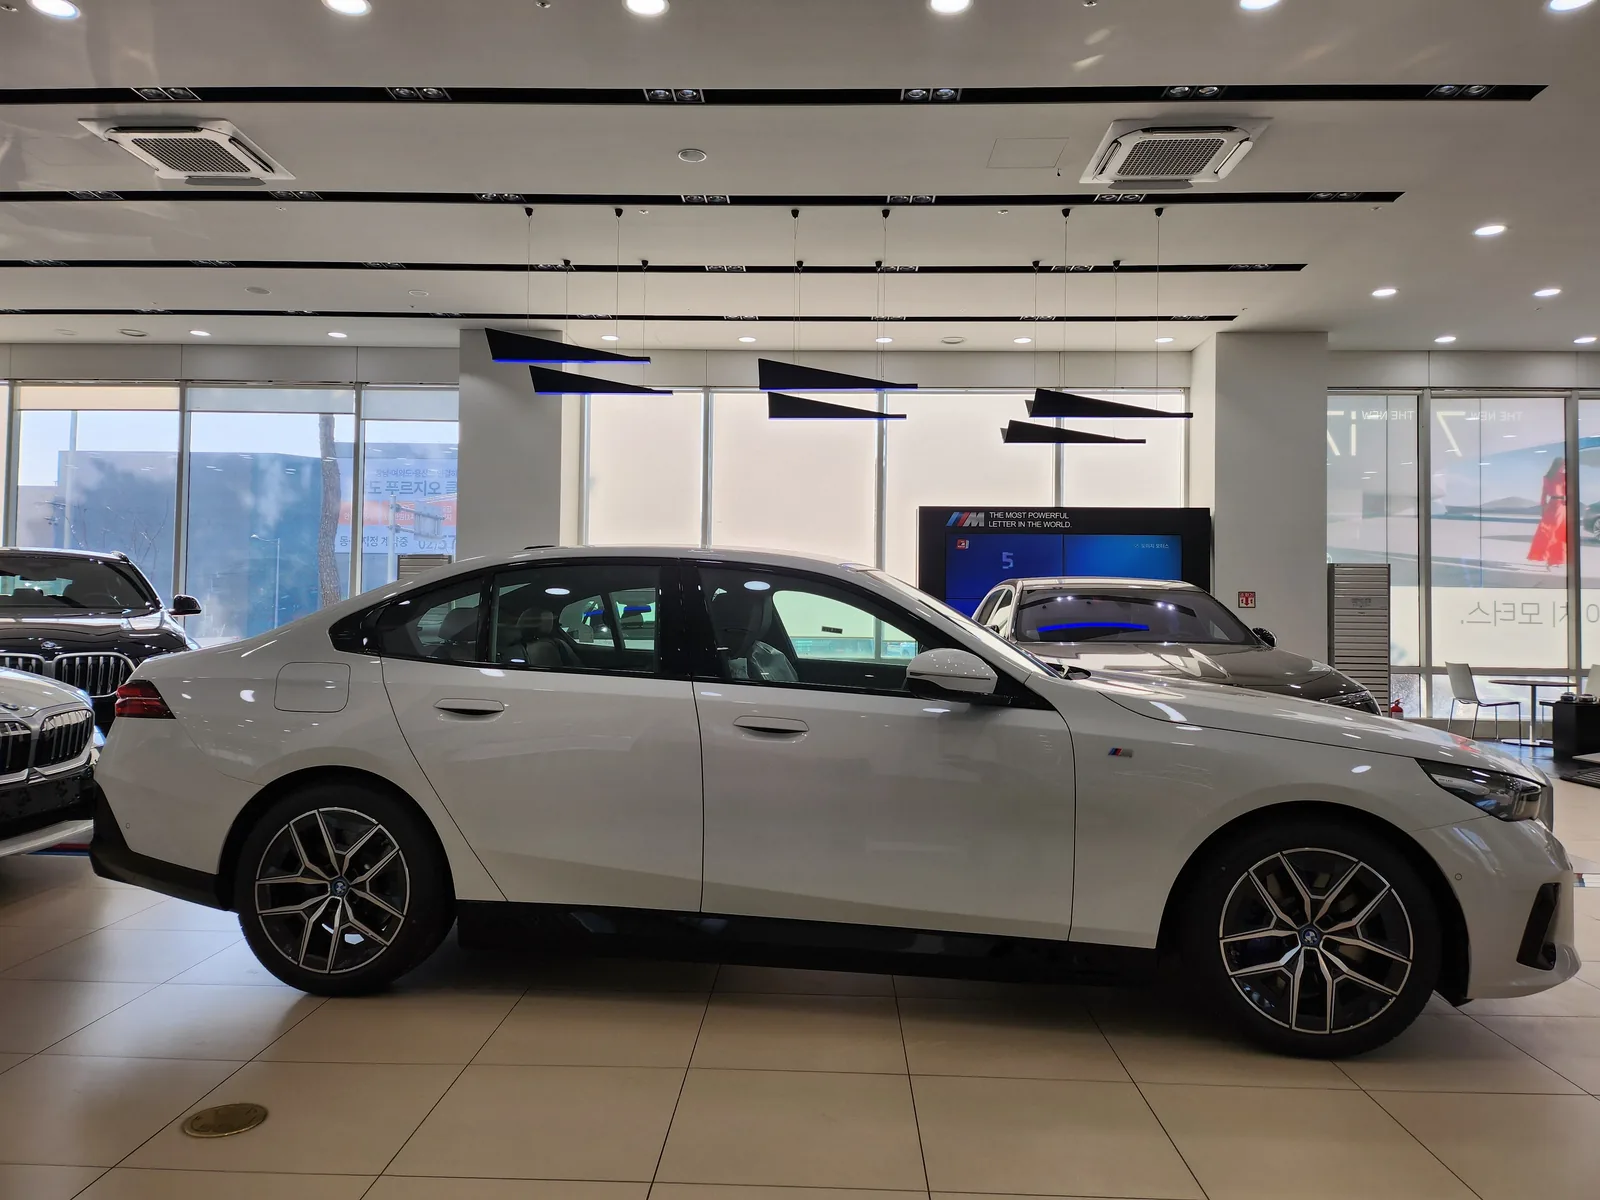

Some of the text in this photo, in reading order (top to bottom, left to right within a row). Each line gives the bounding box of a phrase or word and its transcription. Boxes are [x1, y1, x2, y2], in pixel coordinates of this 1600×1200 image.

[385, 480, 442, 496] 푸르지오
[989, 511, 1069, 520] THE MOST POWERFUL
[988, 520, 1017, 528] LETTER
[1002, 551, 1015, 570] 5
